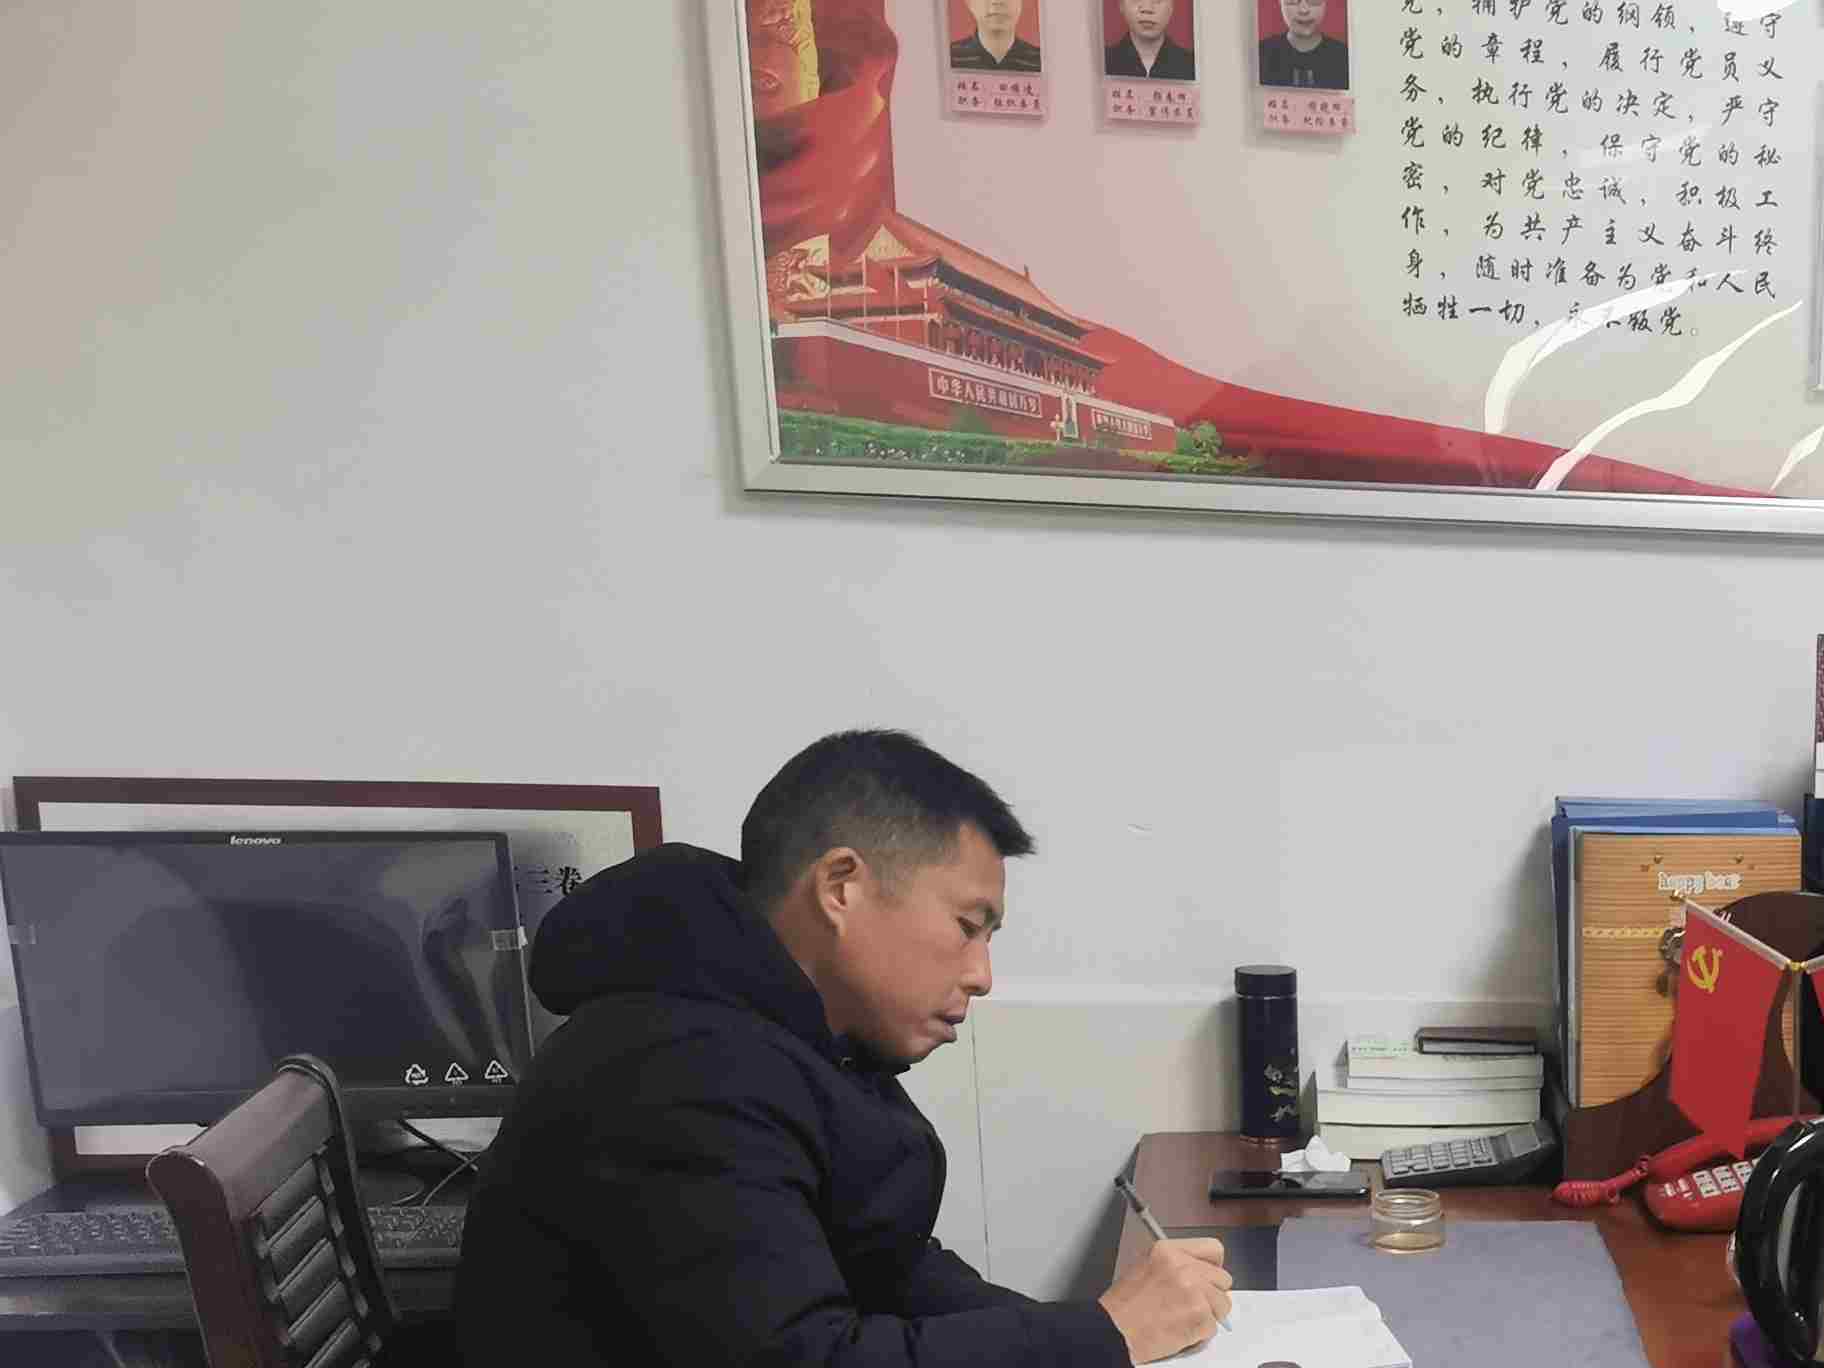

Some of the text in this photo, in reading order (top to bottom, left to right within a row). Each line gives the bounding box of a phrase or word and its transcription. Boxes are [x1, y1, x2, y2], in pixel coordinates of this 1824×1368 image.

[1402, 292, 1698, 336] 牺牲一切，叛党。
